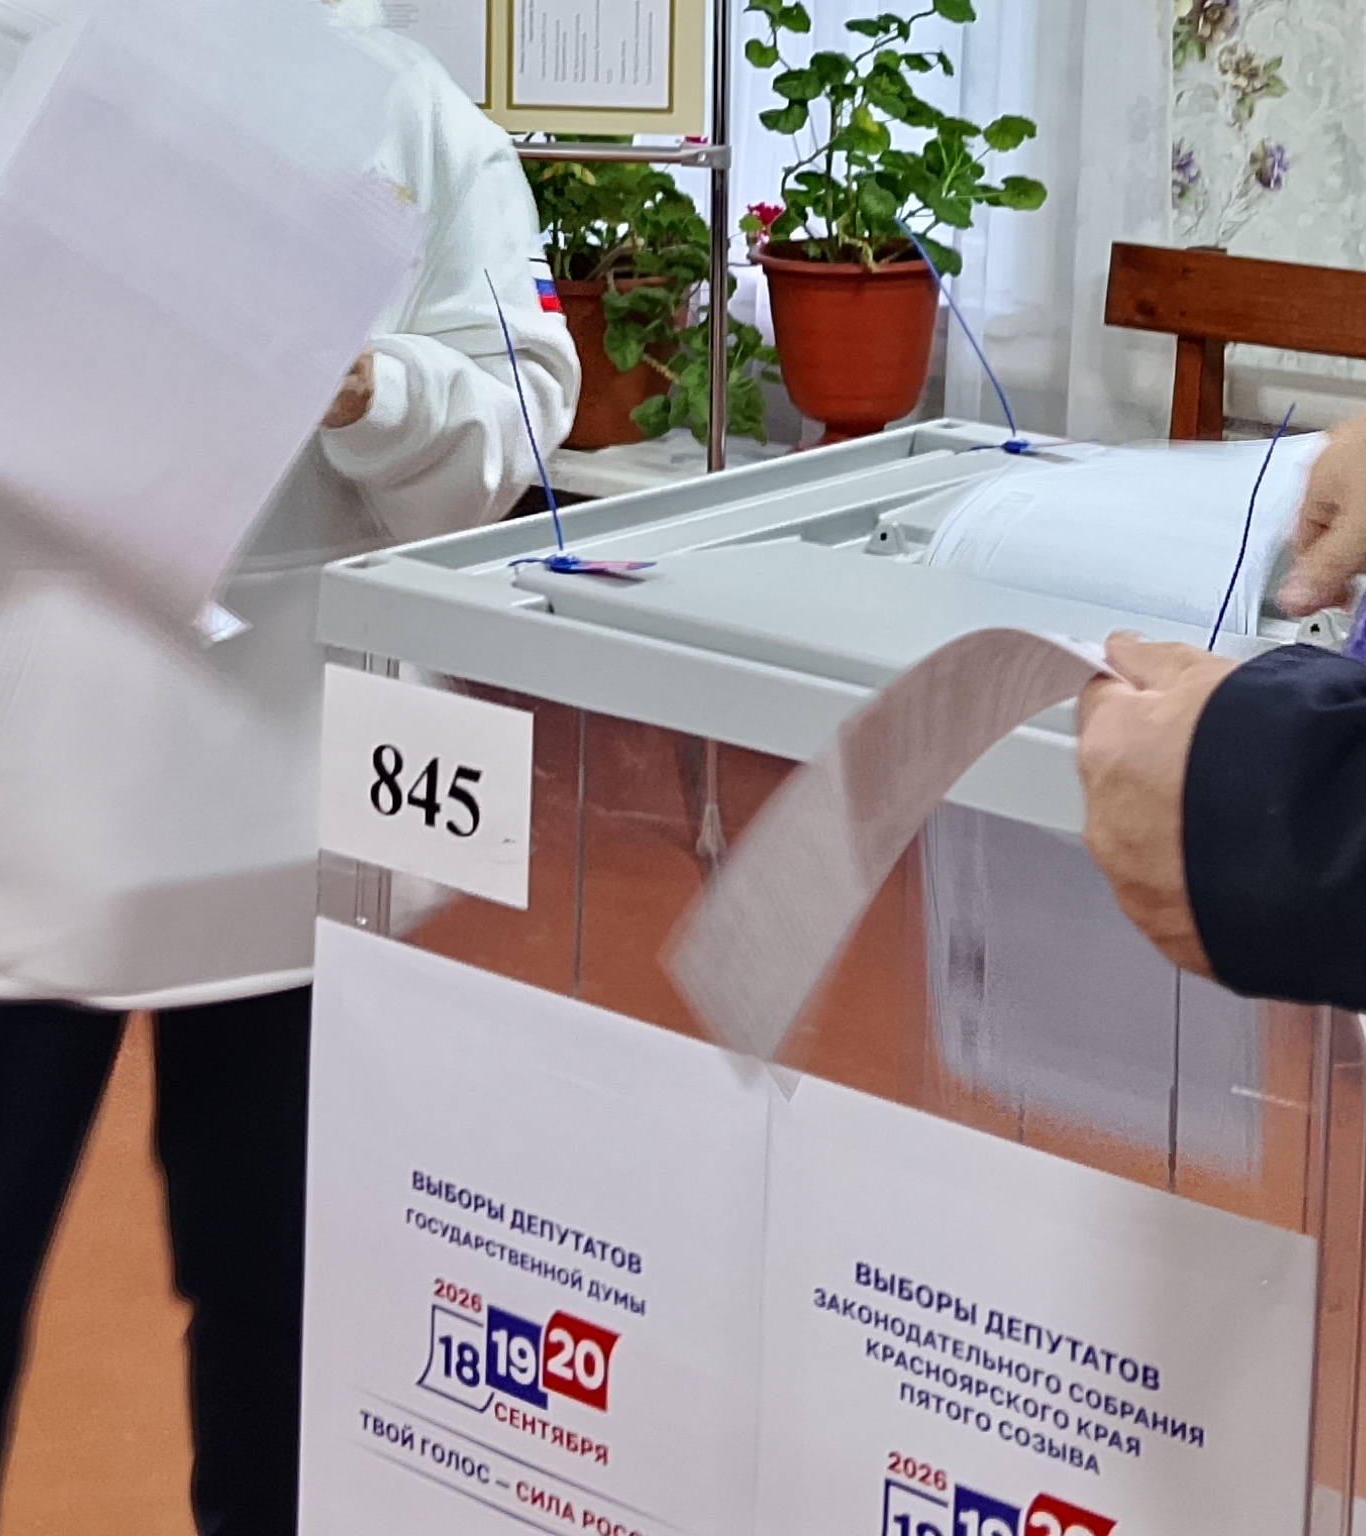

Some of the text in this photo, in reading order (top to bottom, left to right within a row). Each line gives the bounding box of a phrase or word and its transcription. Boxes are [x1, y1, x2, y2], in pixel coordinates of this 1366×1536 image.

[370, 744, 483, 838] 845
[405, 1207, 646, 1316] ГОСУДАРСТВЕННОЙ ДУМЫ
[411, 1169, 643, 1275] ВЫБОРЫ ДЕПУТАТОВ
[433, 1277, 482, 1314] 2026
[854, 1261, 1160, 1391] ВЫБОРЫ ДЕПУТАТОВ
[438, 1327, 606, 1391] 18 19 20
[812, 1287, 1205, 1448] ЗАКОНОДАТЕЛЬНОГО СОБРАНИЯ
[865, 1338, 1141, 1458] КРАСНОЯРСКОГО КРАЯ
[359, 1409, 414, 1451] ТВОЙ
[420, 1438, 490, 1485] ГОЛОС
[516, 1480, 575, 1523] СИЛА
[582, 1509, 643, 1536] РОС
[494, 1401, 609, 1465] СЕНТЯБРЯ
[887, 1450, 948, 1492] 2026
[898, 1381, 1101, 1475] ПЯТОГО СОЗЫВА
